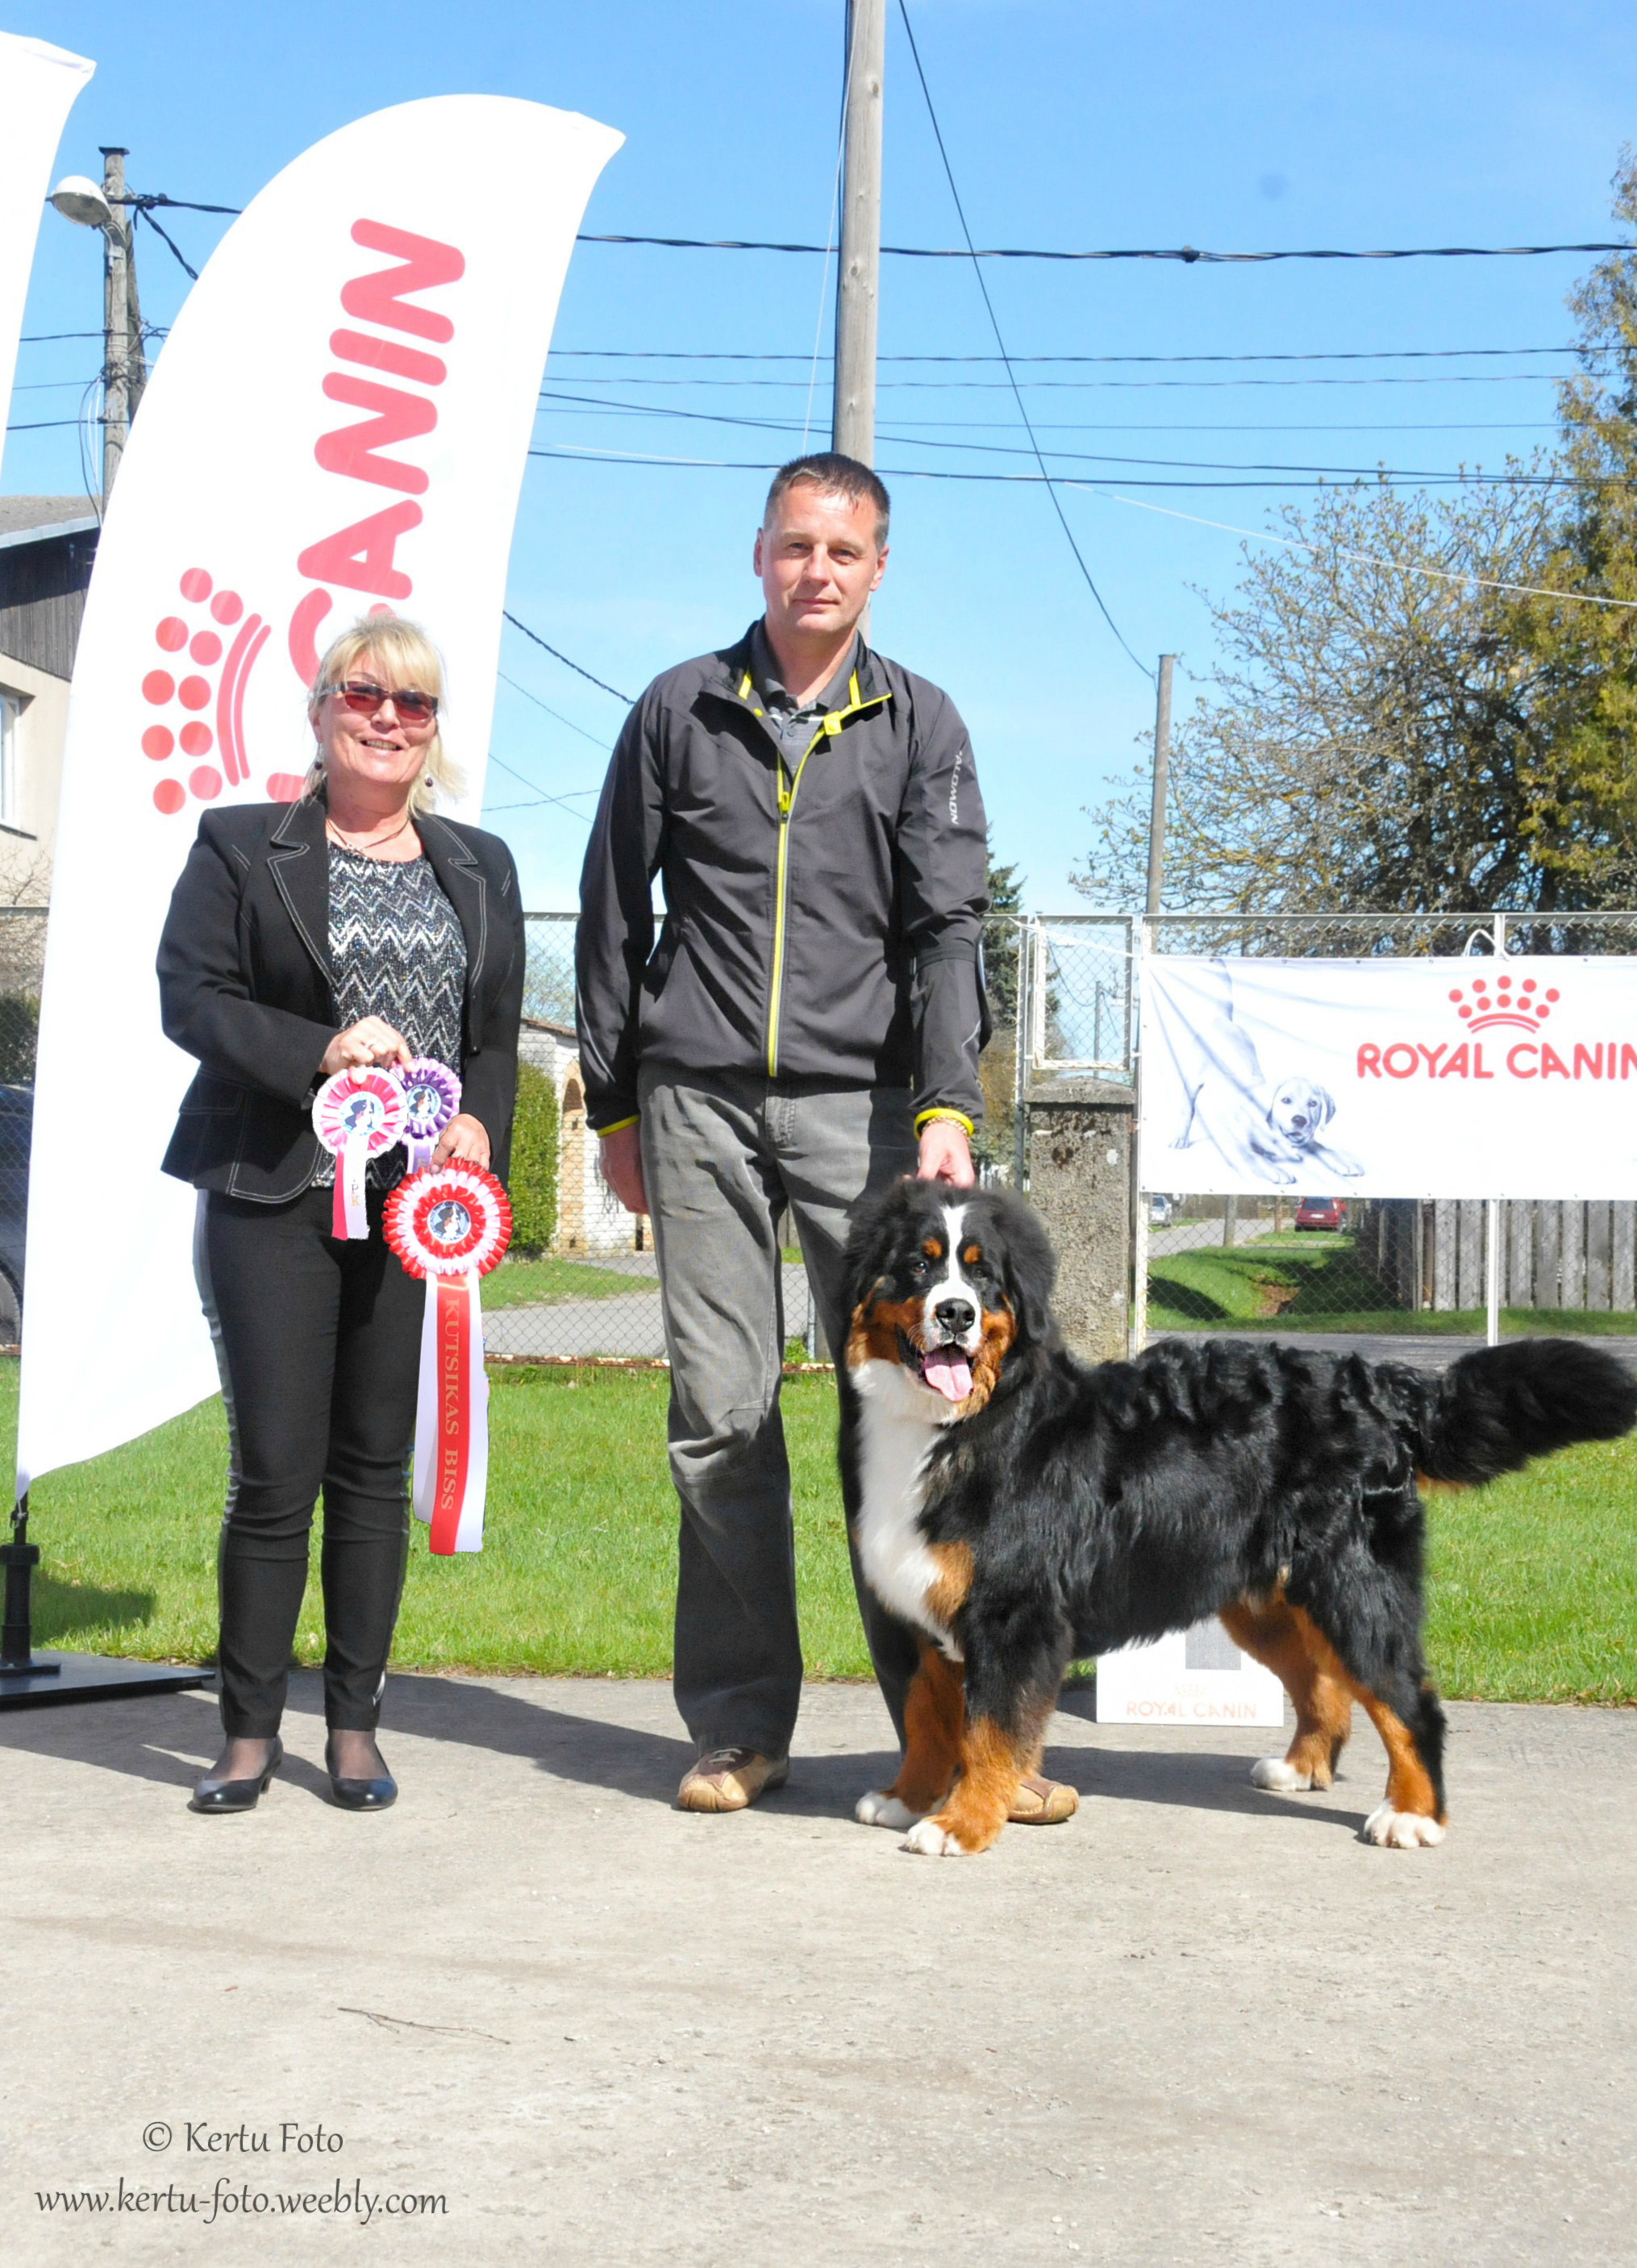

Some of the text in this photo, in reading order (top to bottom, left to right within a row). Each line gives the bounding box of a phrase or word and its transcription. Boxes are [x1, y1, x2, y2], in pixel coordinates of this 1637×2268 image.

[949, 750, 963, 825] ALOMON
[1357, 1042, 1494, 1079] ROYAL
[440, 1297, 460, 1510] KUTSIKAS BISS
[1126, 1701, 1257, 1719] ROYAL CANIN
